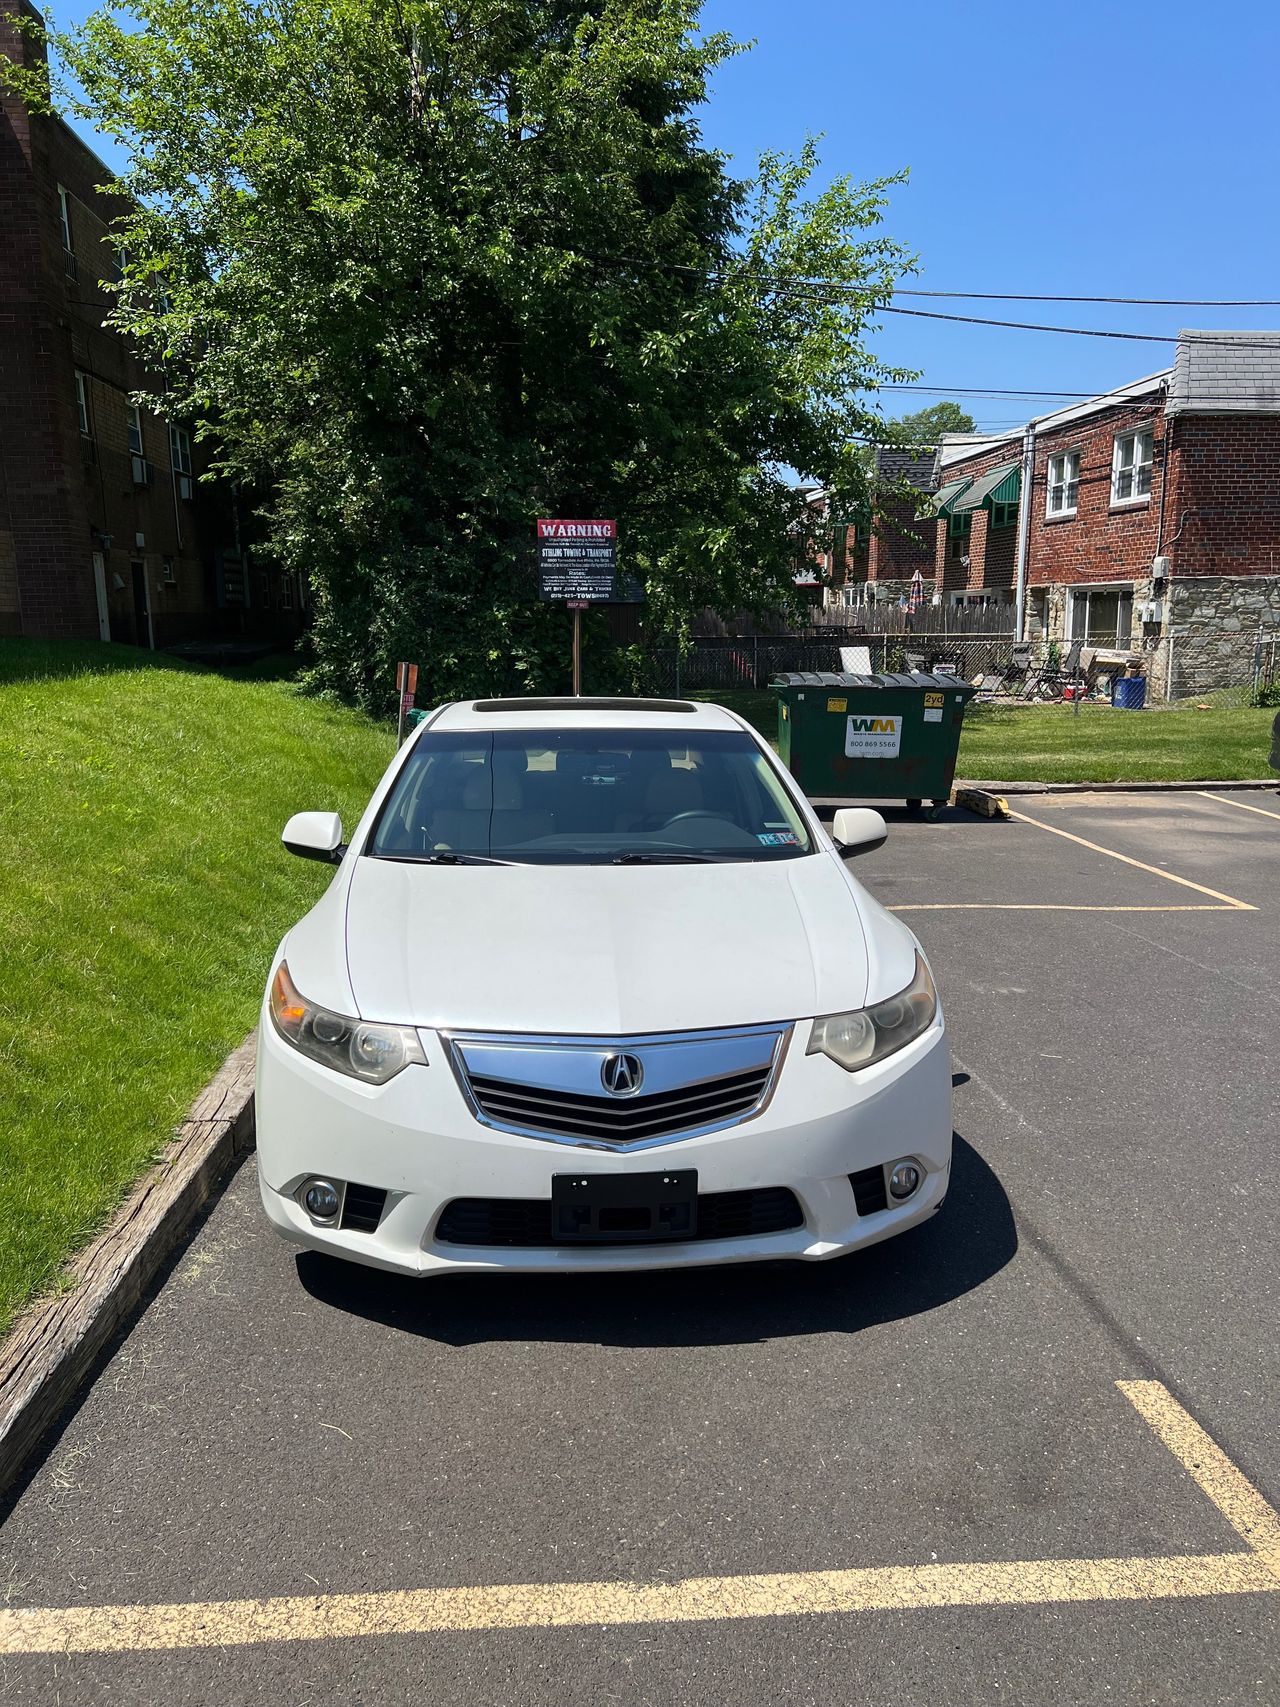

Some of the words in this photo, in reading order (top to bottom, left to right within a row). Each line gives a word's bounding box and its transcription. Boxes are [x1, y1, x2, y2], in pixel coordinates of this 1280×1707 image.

[541, 524, 612, 536] WARNING
[563, 548, 581, 557] TOWING
[586, 548, 612, 557] TRANSPORT
[926, 695, 943, 704] 2yd
[852, 719, 895, 732] WM
